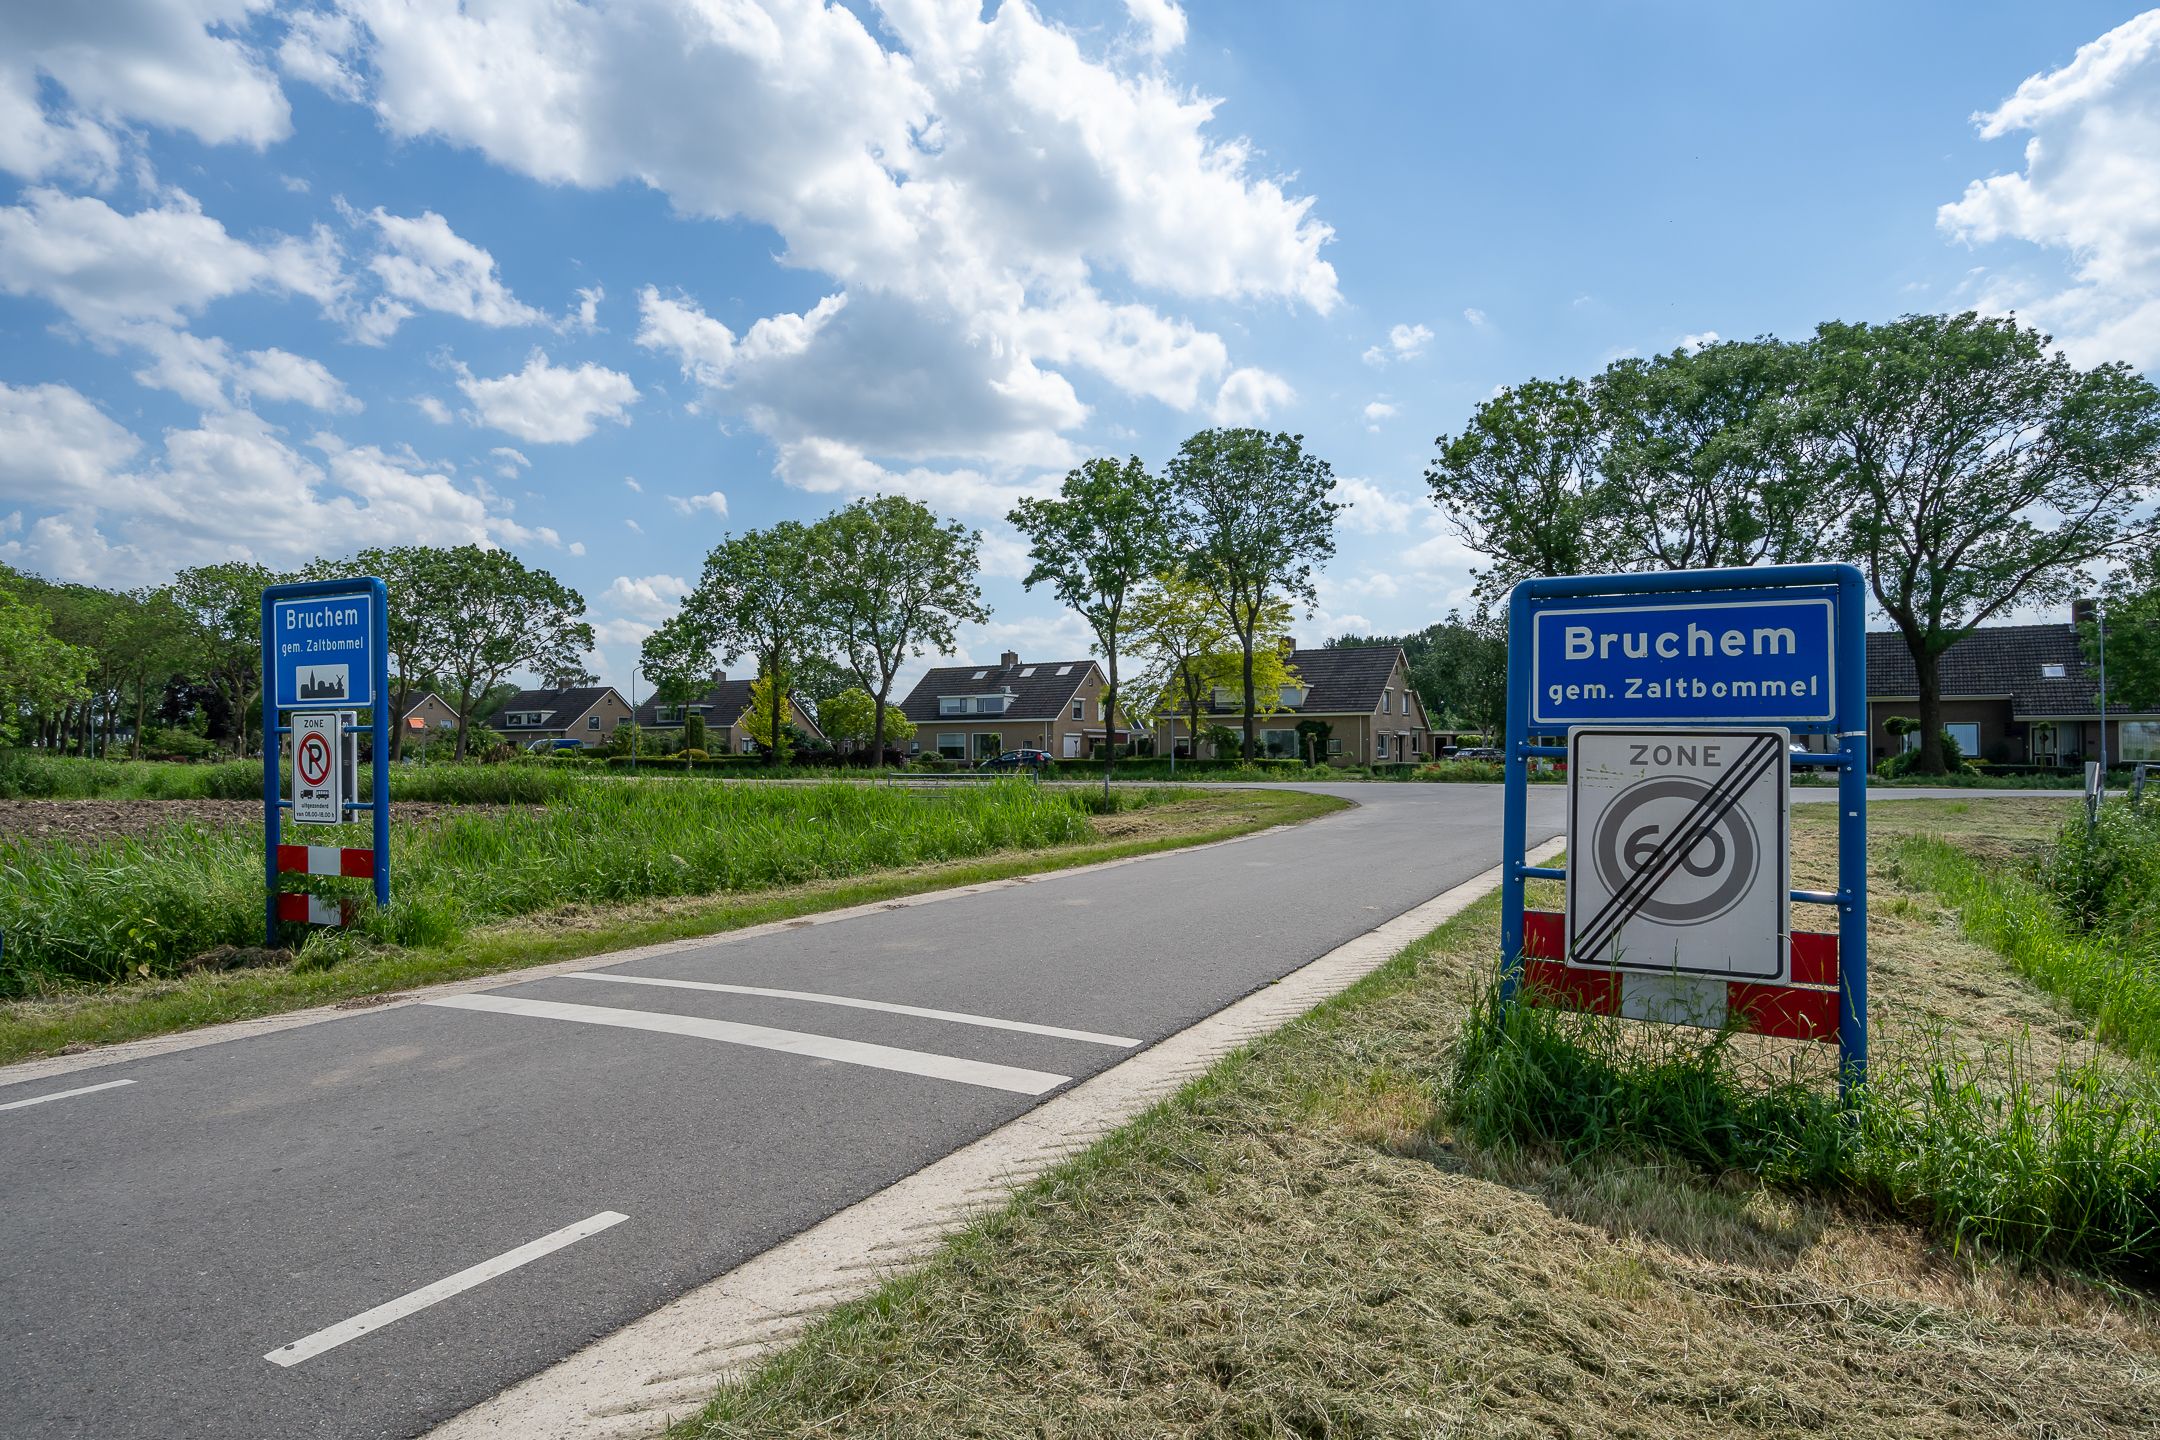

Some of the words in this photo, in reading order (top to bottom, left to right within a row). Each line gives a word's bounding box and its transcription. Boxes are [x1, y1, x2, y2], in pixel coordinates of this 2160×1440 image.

[286, 606, 358, 630] Bruchem
[281, 642, 304, 657] gem.
[306, 636, 364, 652] Zaltbommel
[1565, 622, 1796, 660] Bruchem
[1548, 682, 1615, 706] gem.
[1624, 675, 1818, 699] Zaltbommel
[304, 719, 324, 728] ZONE
[1629, 744, 1722, 767] ZONE
[1623, 824, 1726, 878] 60
